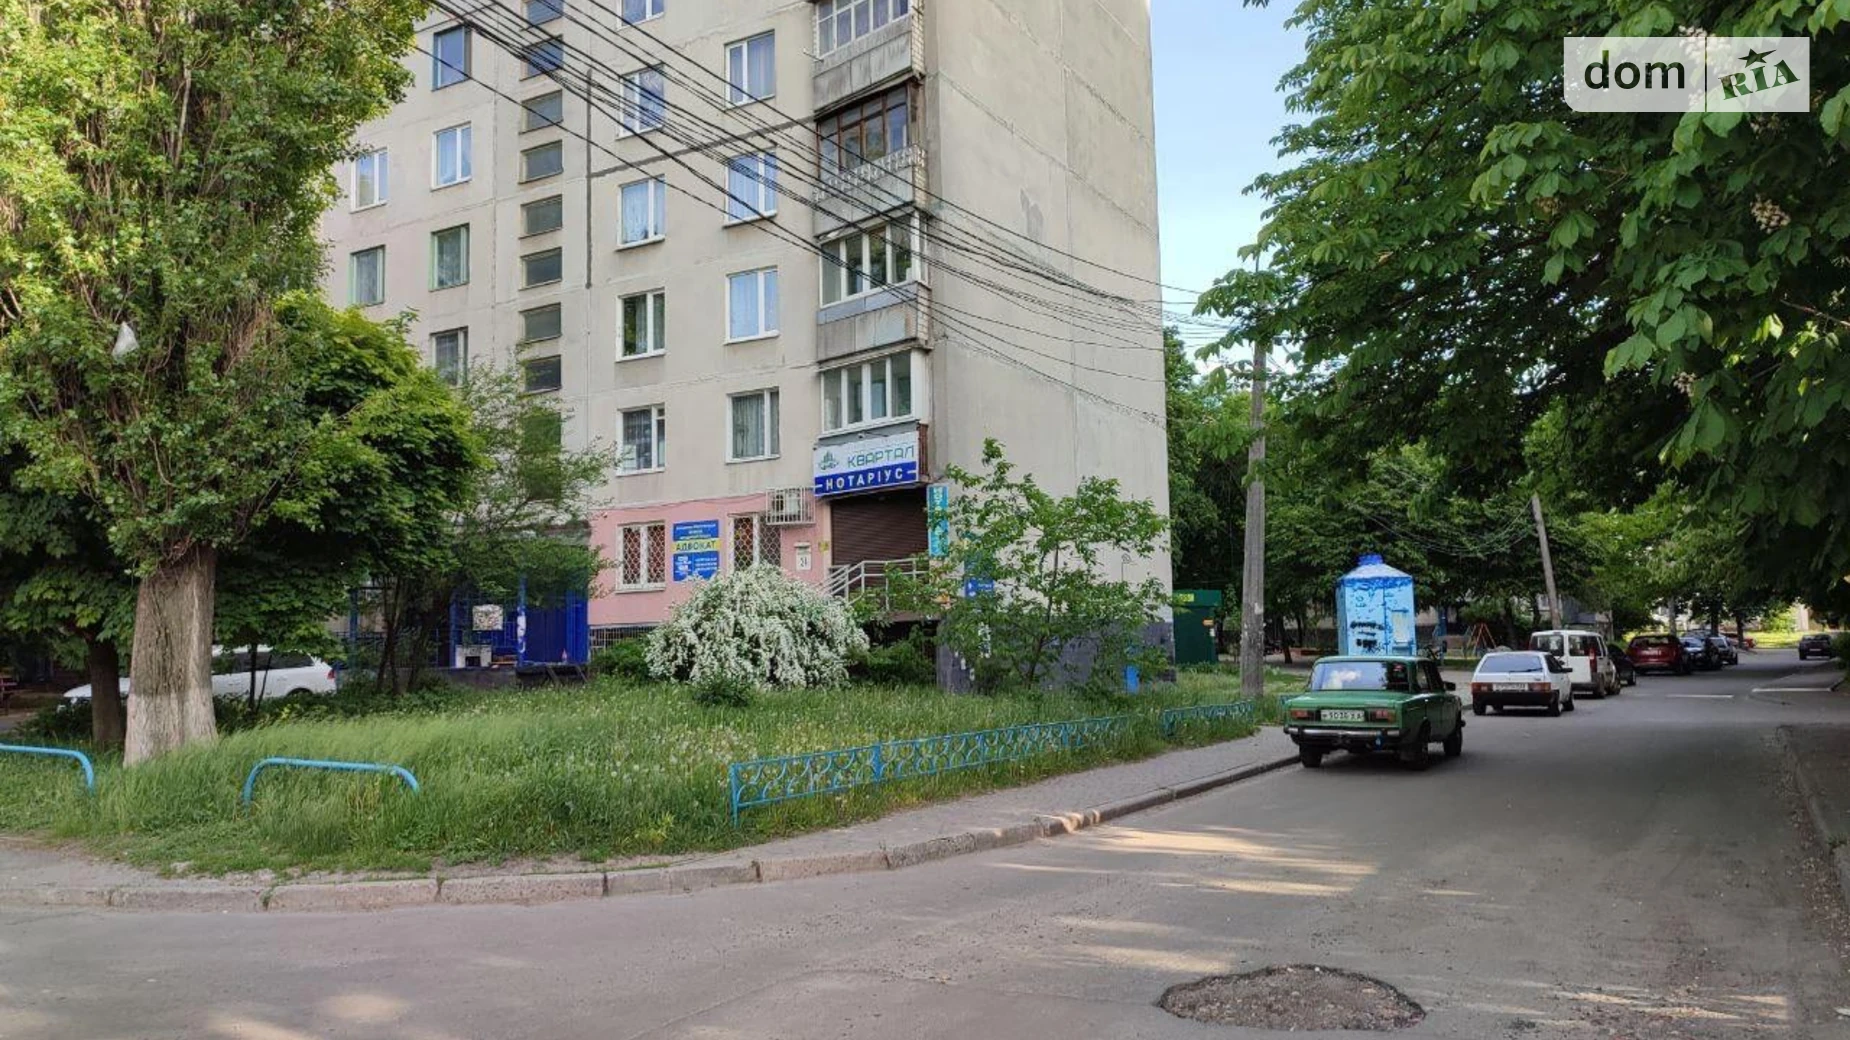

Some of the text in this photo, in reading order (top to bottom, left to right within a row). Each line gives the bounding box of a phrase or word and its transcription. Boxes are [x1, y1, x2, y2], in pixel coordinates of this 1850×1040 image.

[847, 444, 914, 468] КВАРТАЛ
[826, 468, 903, 491] НОТАРІУС
[676, 540, 716, 551] АДВОКАТ
